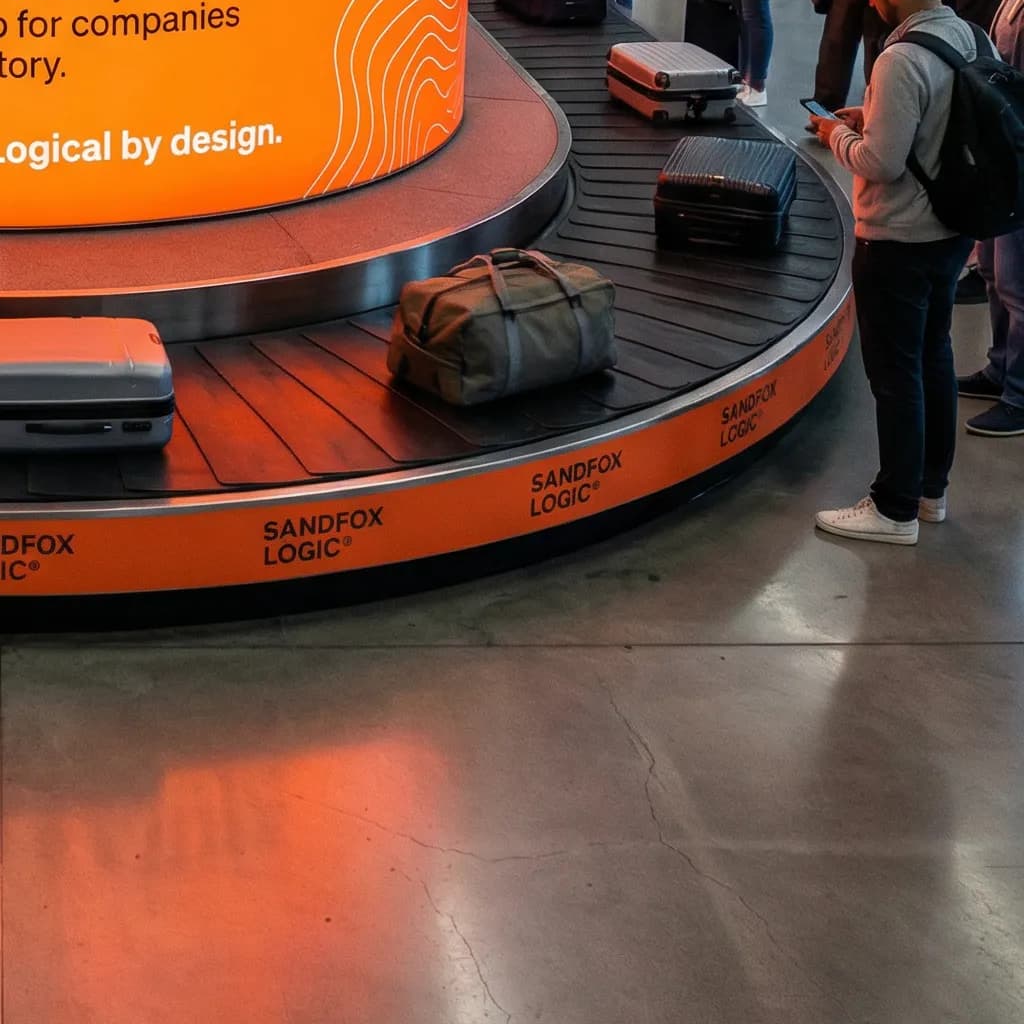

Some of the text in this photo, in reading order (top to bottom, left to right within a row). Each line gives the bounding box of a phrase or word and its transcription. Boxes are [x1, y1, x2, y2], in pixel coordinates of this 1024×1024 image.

[17, 8, 63, 38] for
[71, 2, 240, 41] companies
[121, 129, 163, 166] by
[170, 119, 283, 157] design.
[721, 379, 777, 424] SANDFOX
[720, 407, 764, 447] LOGIC
[530, 449, 623, 493] SANDFOX
[263, 505, 384, 541] SANDFOX
